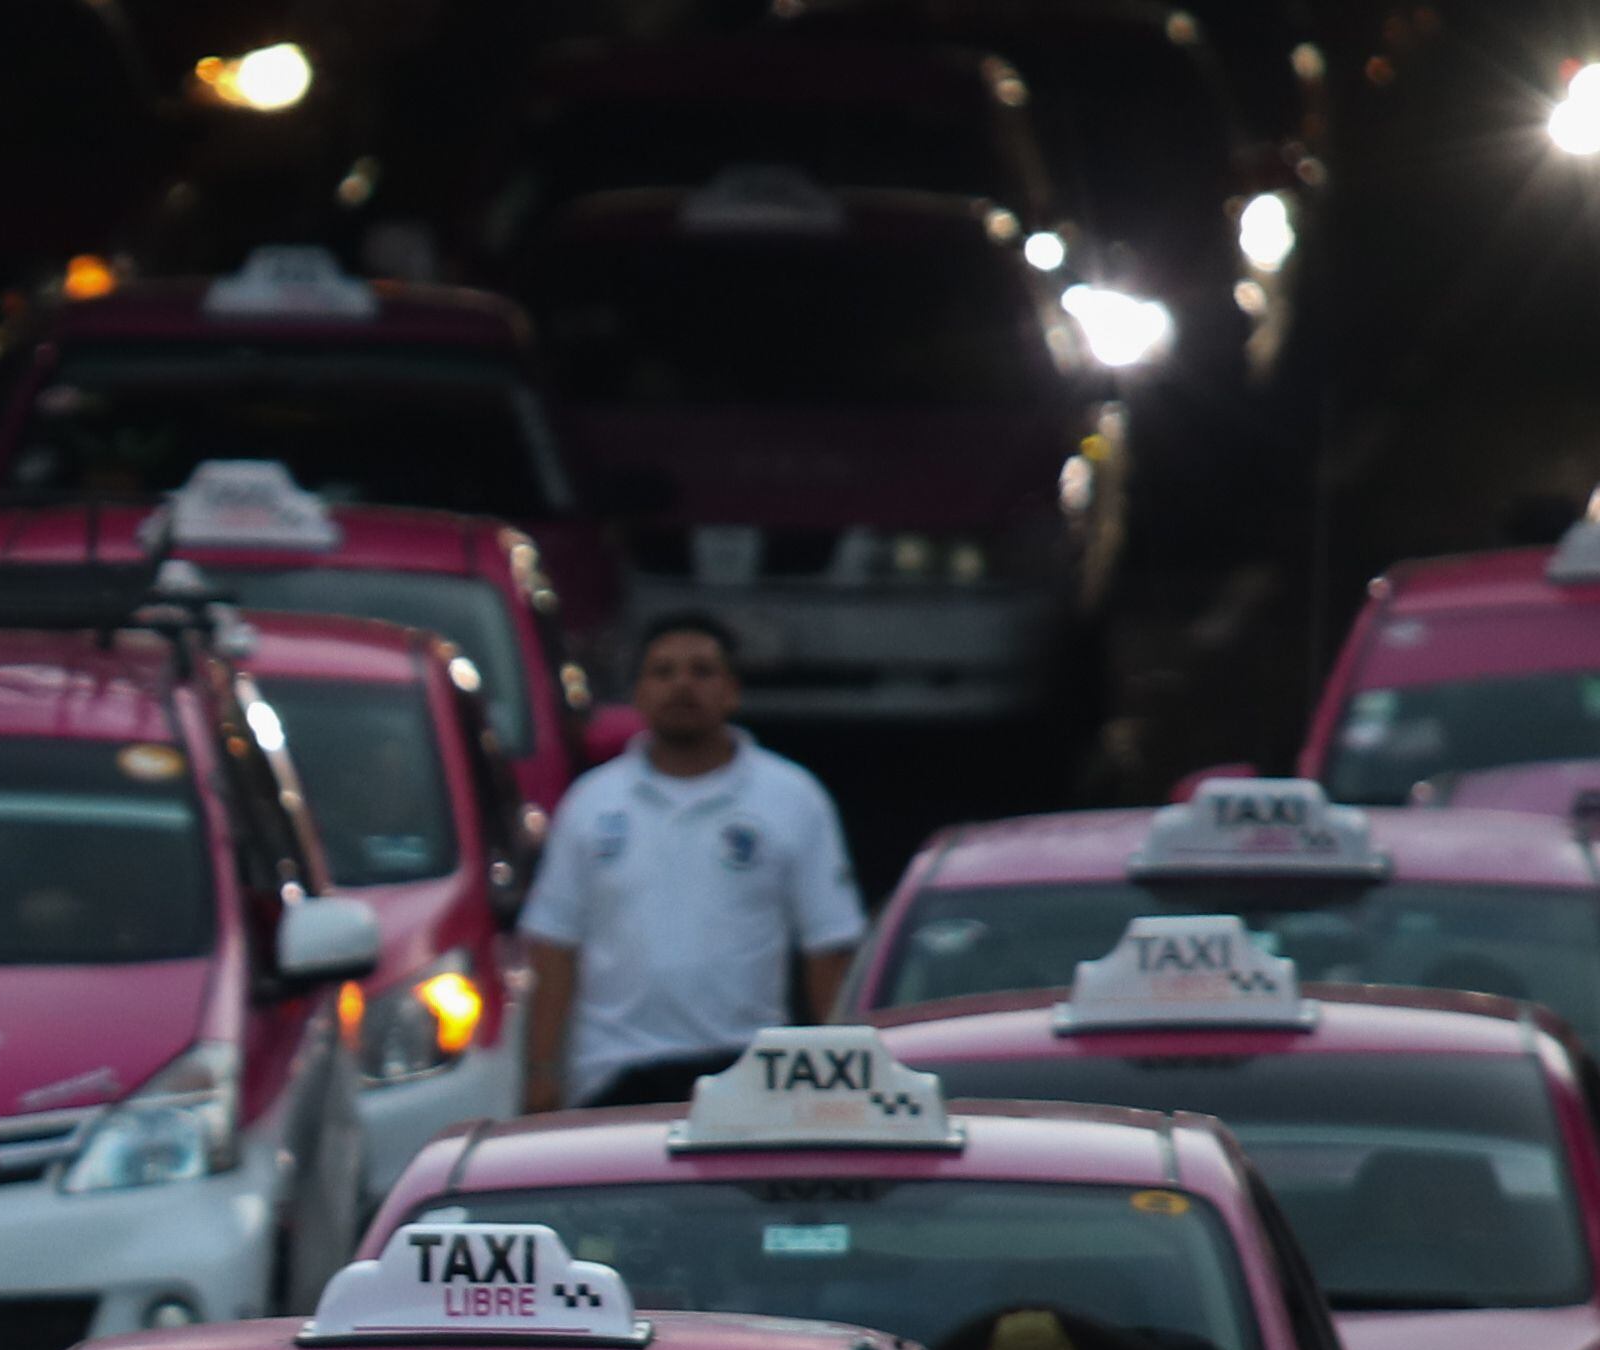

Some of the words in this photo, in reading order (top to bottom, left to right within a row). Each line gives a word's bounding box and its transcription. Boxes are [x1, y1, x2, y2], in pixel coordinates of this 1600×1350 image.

[1211, 795, 1306, 831] TAXI
[1130, 934, 1232, 973] TAXI
[757, 1049, 872, 1090] TAXI
[409, 1233, 535, 1284] TAXI
[445, 1287, 536, 1317] LIBRE
